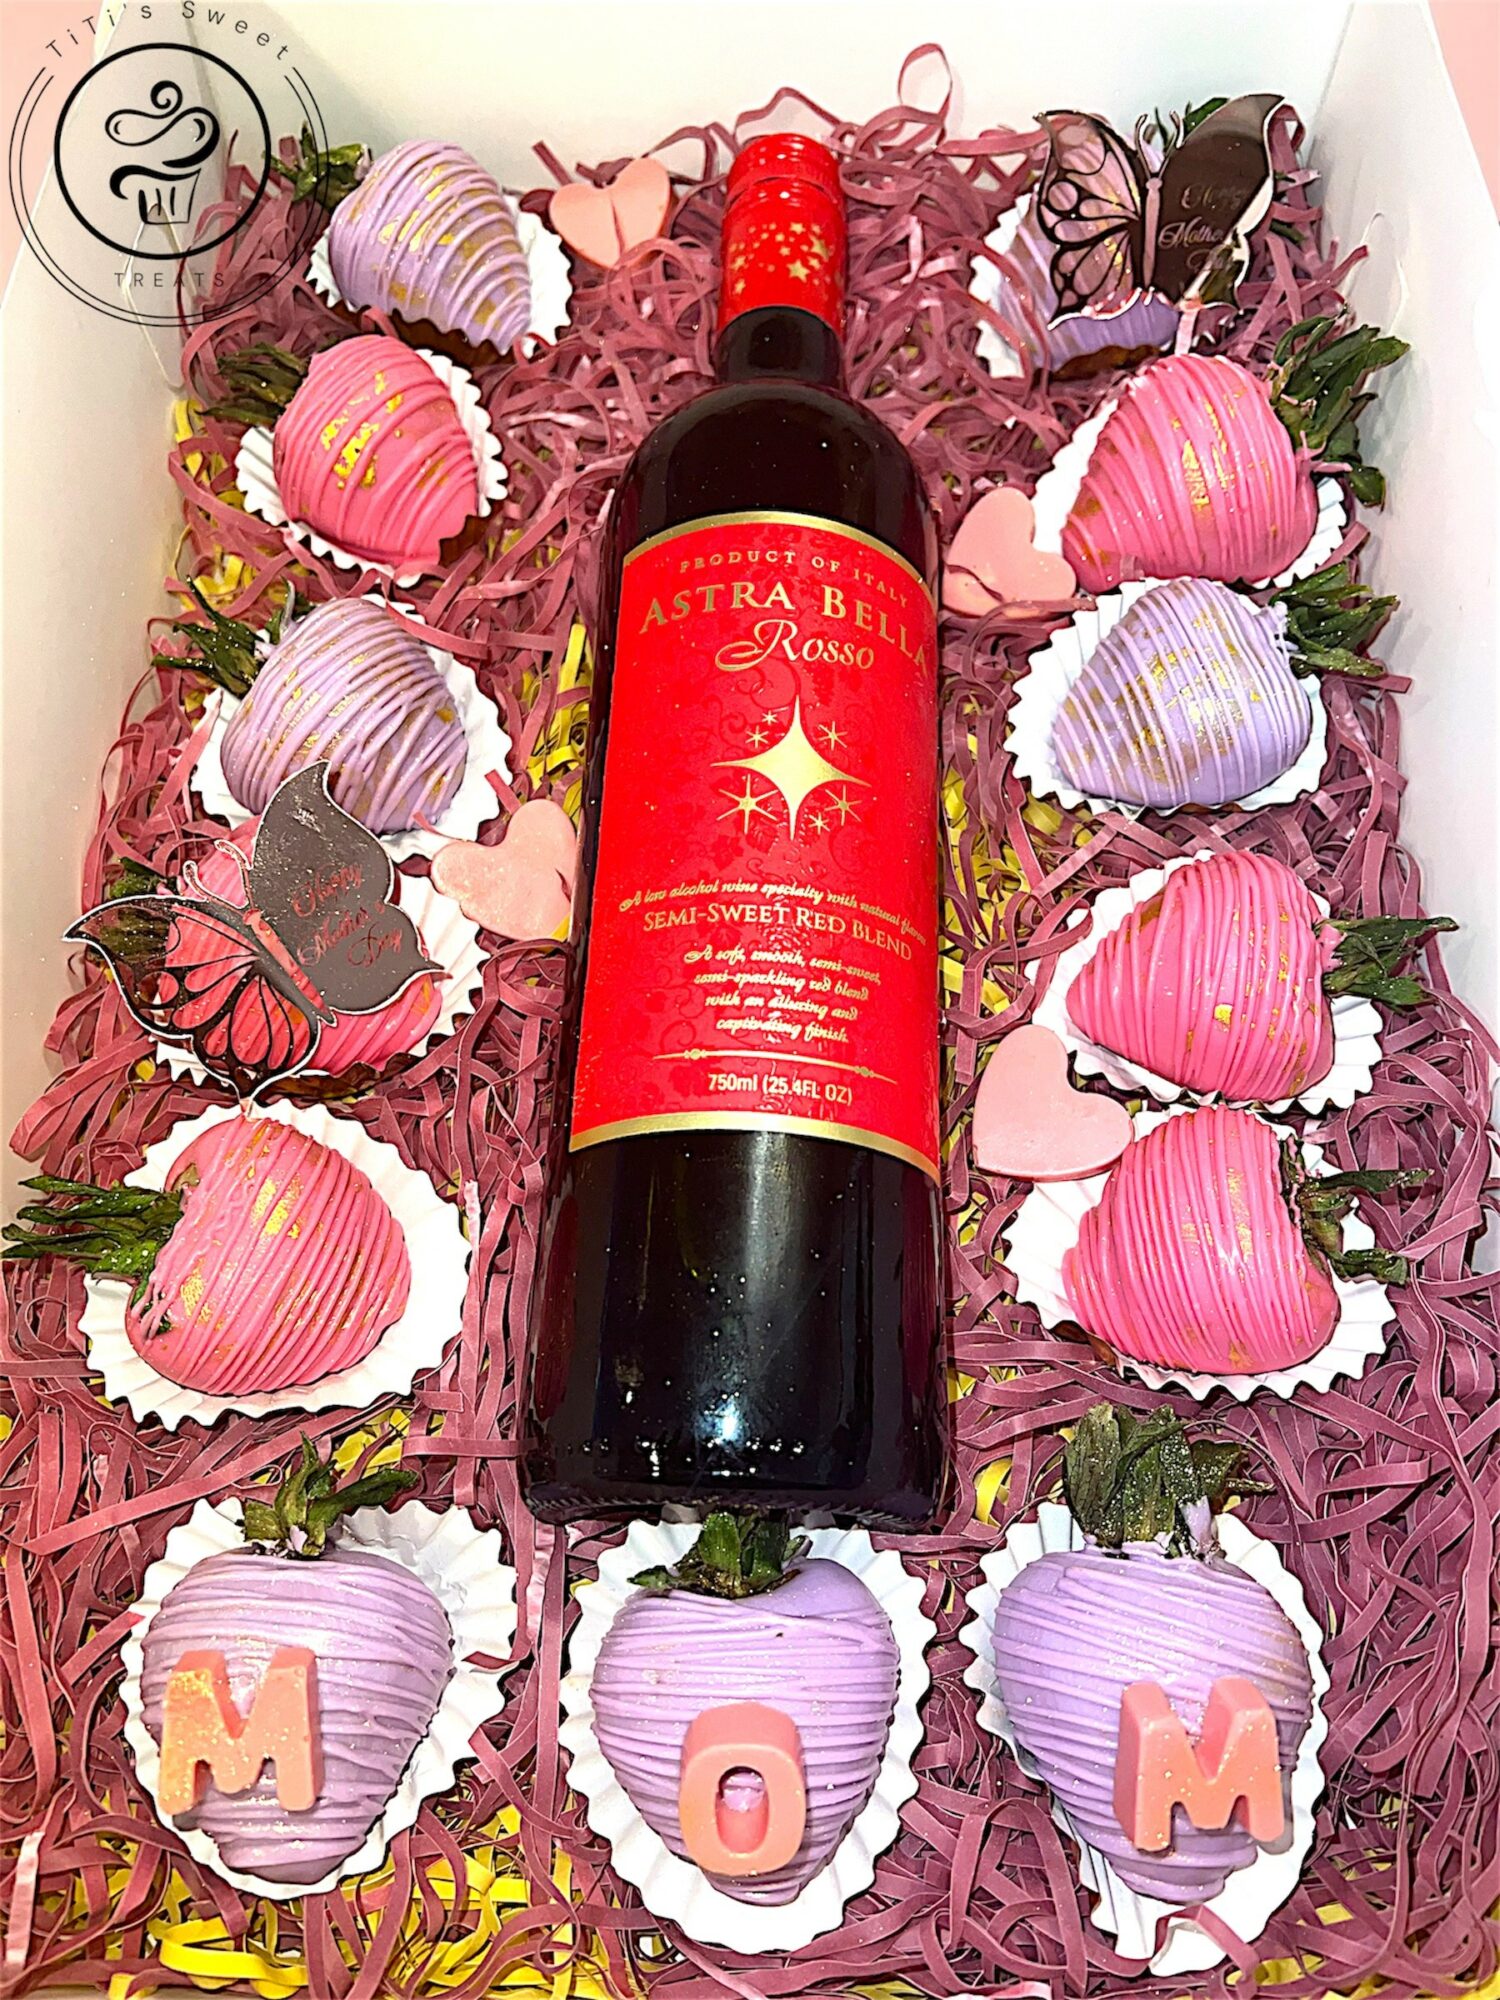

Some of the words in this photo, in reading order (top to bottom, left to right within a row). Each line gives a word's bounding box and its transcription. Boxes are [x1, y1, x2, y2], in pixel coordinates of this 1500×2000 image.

[679, 550, 796, 574] PRODUCT
[811, 556, 841, 572] OF
[853, 568, 908, 609] ITALY
[638, 580, 796, 635] ASTRA
[821, 583, 929, 678] BELLA
[644, 889, 667, 904] low
[669, 879, 720, 898] alcohol
[721, 877, 759, 893] wine
[760, 882, 824, 905] specialty
[827, 889, 858, 909] with
[860, 902, 900, 926] natural
[643, 902, 791, 932] SEMI-SWEET
[796, 906, 846, 934] RED
[852, 919, 912, 961] BLEND
[684, 944, 713, 963] A
[715, 945, 746, 965] soft,
[751, 947, 806, 968] smooth,
[809, 956, 881, 985] semi-sweet,
[694, 969, 806, 993] semi-sparkling
[809, 974, 832, 991] red
[835, 980, 869, 1001] blend
[705, 989, 741, 1007] with
[744, 995, 765, 1007] an
[768, 995, 829, 1021] alluring
[831, 1006, 860, 1021] and
[716, 1016, 802, 1041] captivating
[804, 1021, 849, 1043] finish.
[708, 1073, 758, 1092] 750ml
[824, 1083, 853, 1107] OZ)
